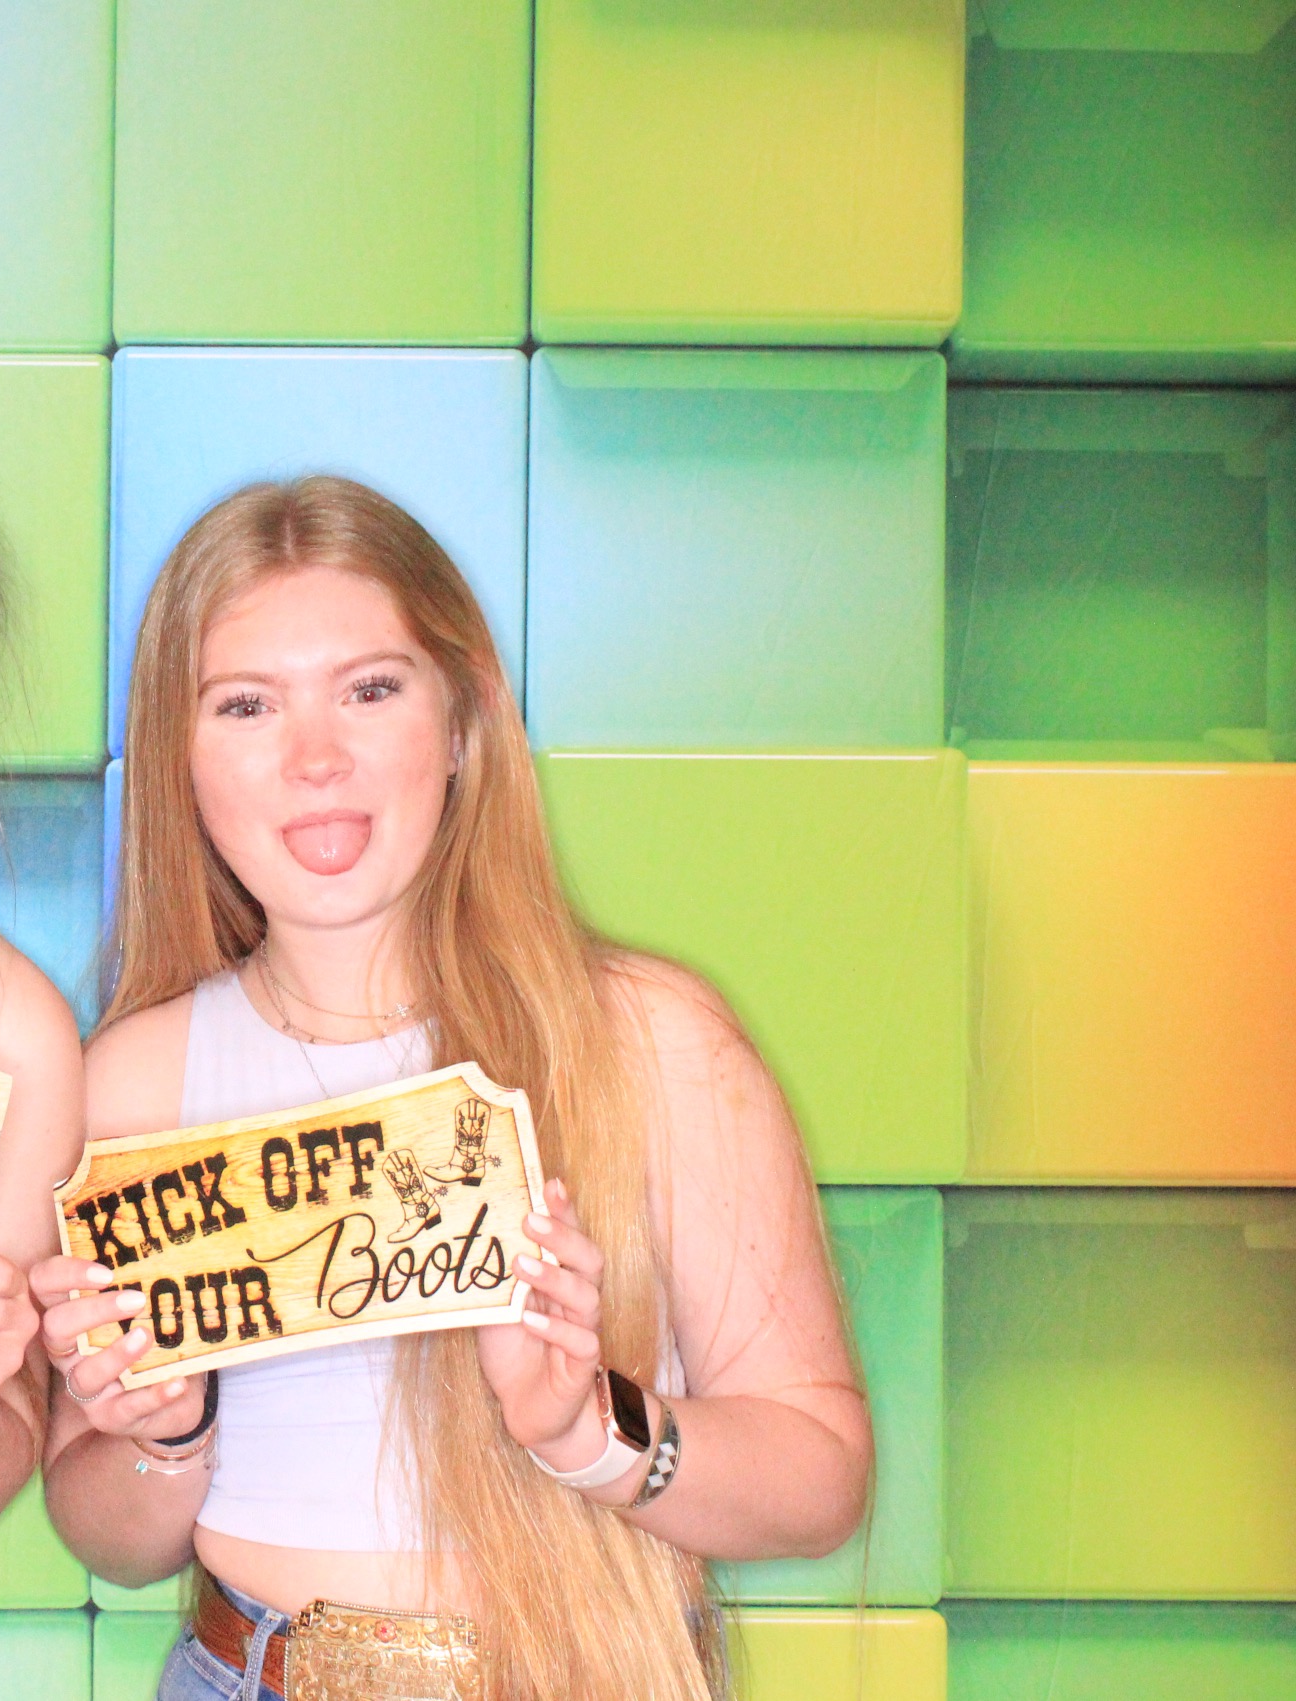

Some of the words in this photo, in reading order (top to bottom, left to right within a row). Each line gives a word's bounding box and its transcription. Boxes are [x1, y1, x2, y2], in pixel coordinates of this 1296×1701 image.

[75, 1151, 247, 1270] KICK
[260, 1120, 386, 1213] OFF
[246, 1202, 515, 1320] Boots
